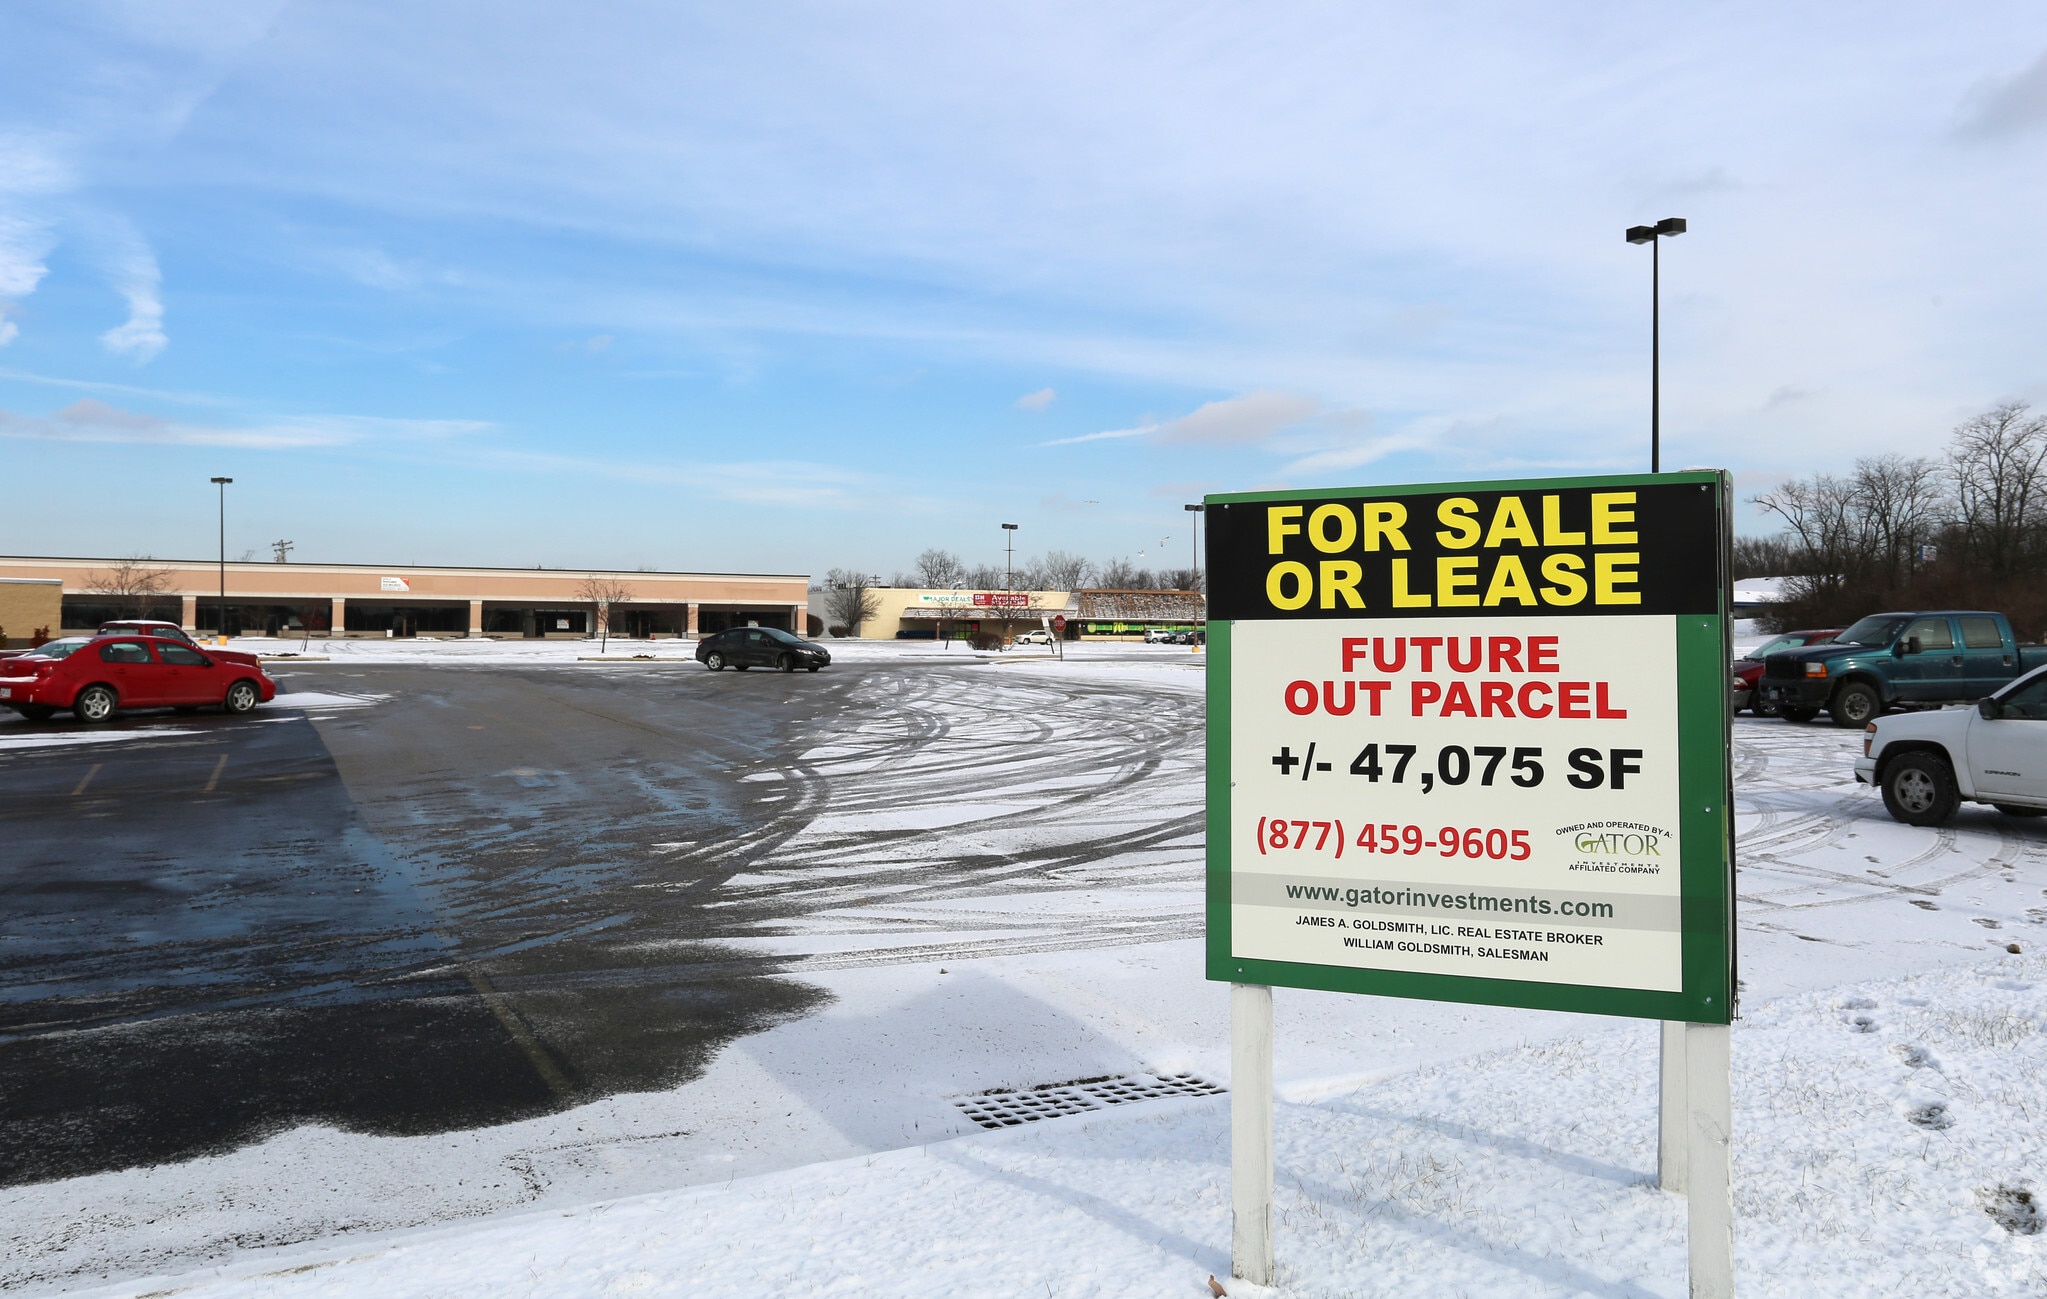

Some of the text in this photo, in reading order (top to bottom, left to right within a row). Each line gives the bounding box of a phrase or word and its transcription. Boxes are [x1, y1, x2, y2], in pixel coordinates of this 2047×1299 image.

[1267, 491, 1639, 555] FOR SALE
[992, 594, 1026, 602] Avaiable
[1265, 551, 1642, 611] OR LEASE
[1341, 636, 1560, 674] FUTURE
[1284, 679, 1628, 720] OUT PARCEL
[1271, 742, 1643, 795] +/- 47,075 SF
[1256, 816, 1532, 861] (877) 459-9605
[1555, 821, 1673, 839] OWNED AND OPERATED BY A:
[1574, 832, 1662, 857] GATOR
[1568, 863, 1661, 875] AFFILIATED COMPANY
[1577, 860, 1659, 868] INVESTMENTS
[1285, 882, 1614, 919] www.gatorinvestments.com
[1295, 915, 1604, 946] JAMES A. GOLDSMITH, LIC. REAL ESTATE BROKER
[1343, 937, 1549, 962] WILLIAM GOLDSMITH, SALESMAN
